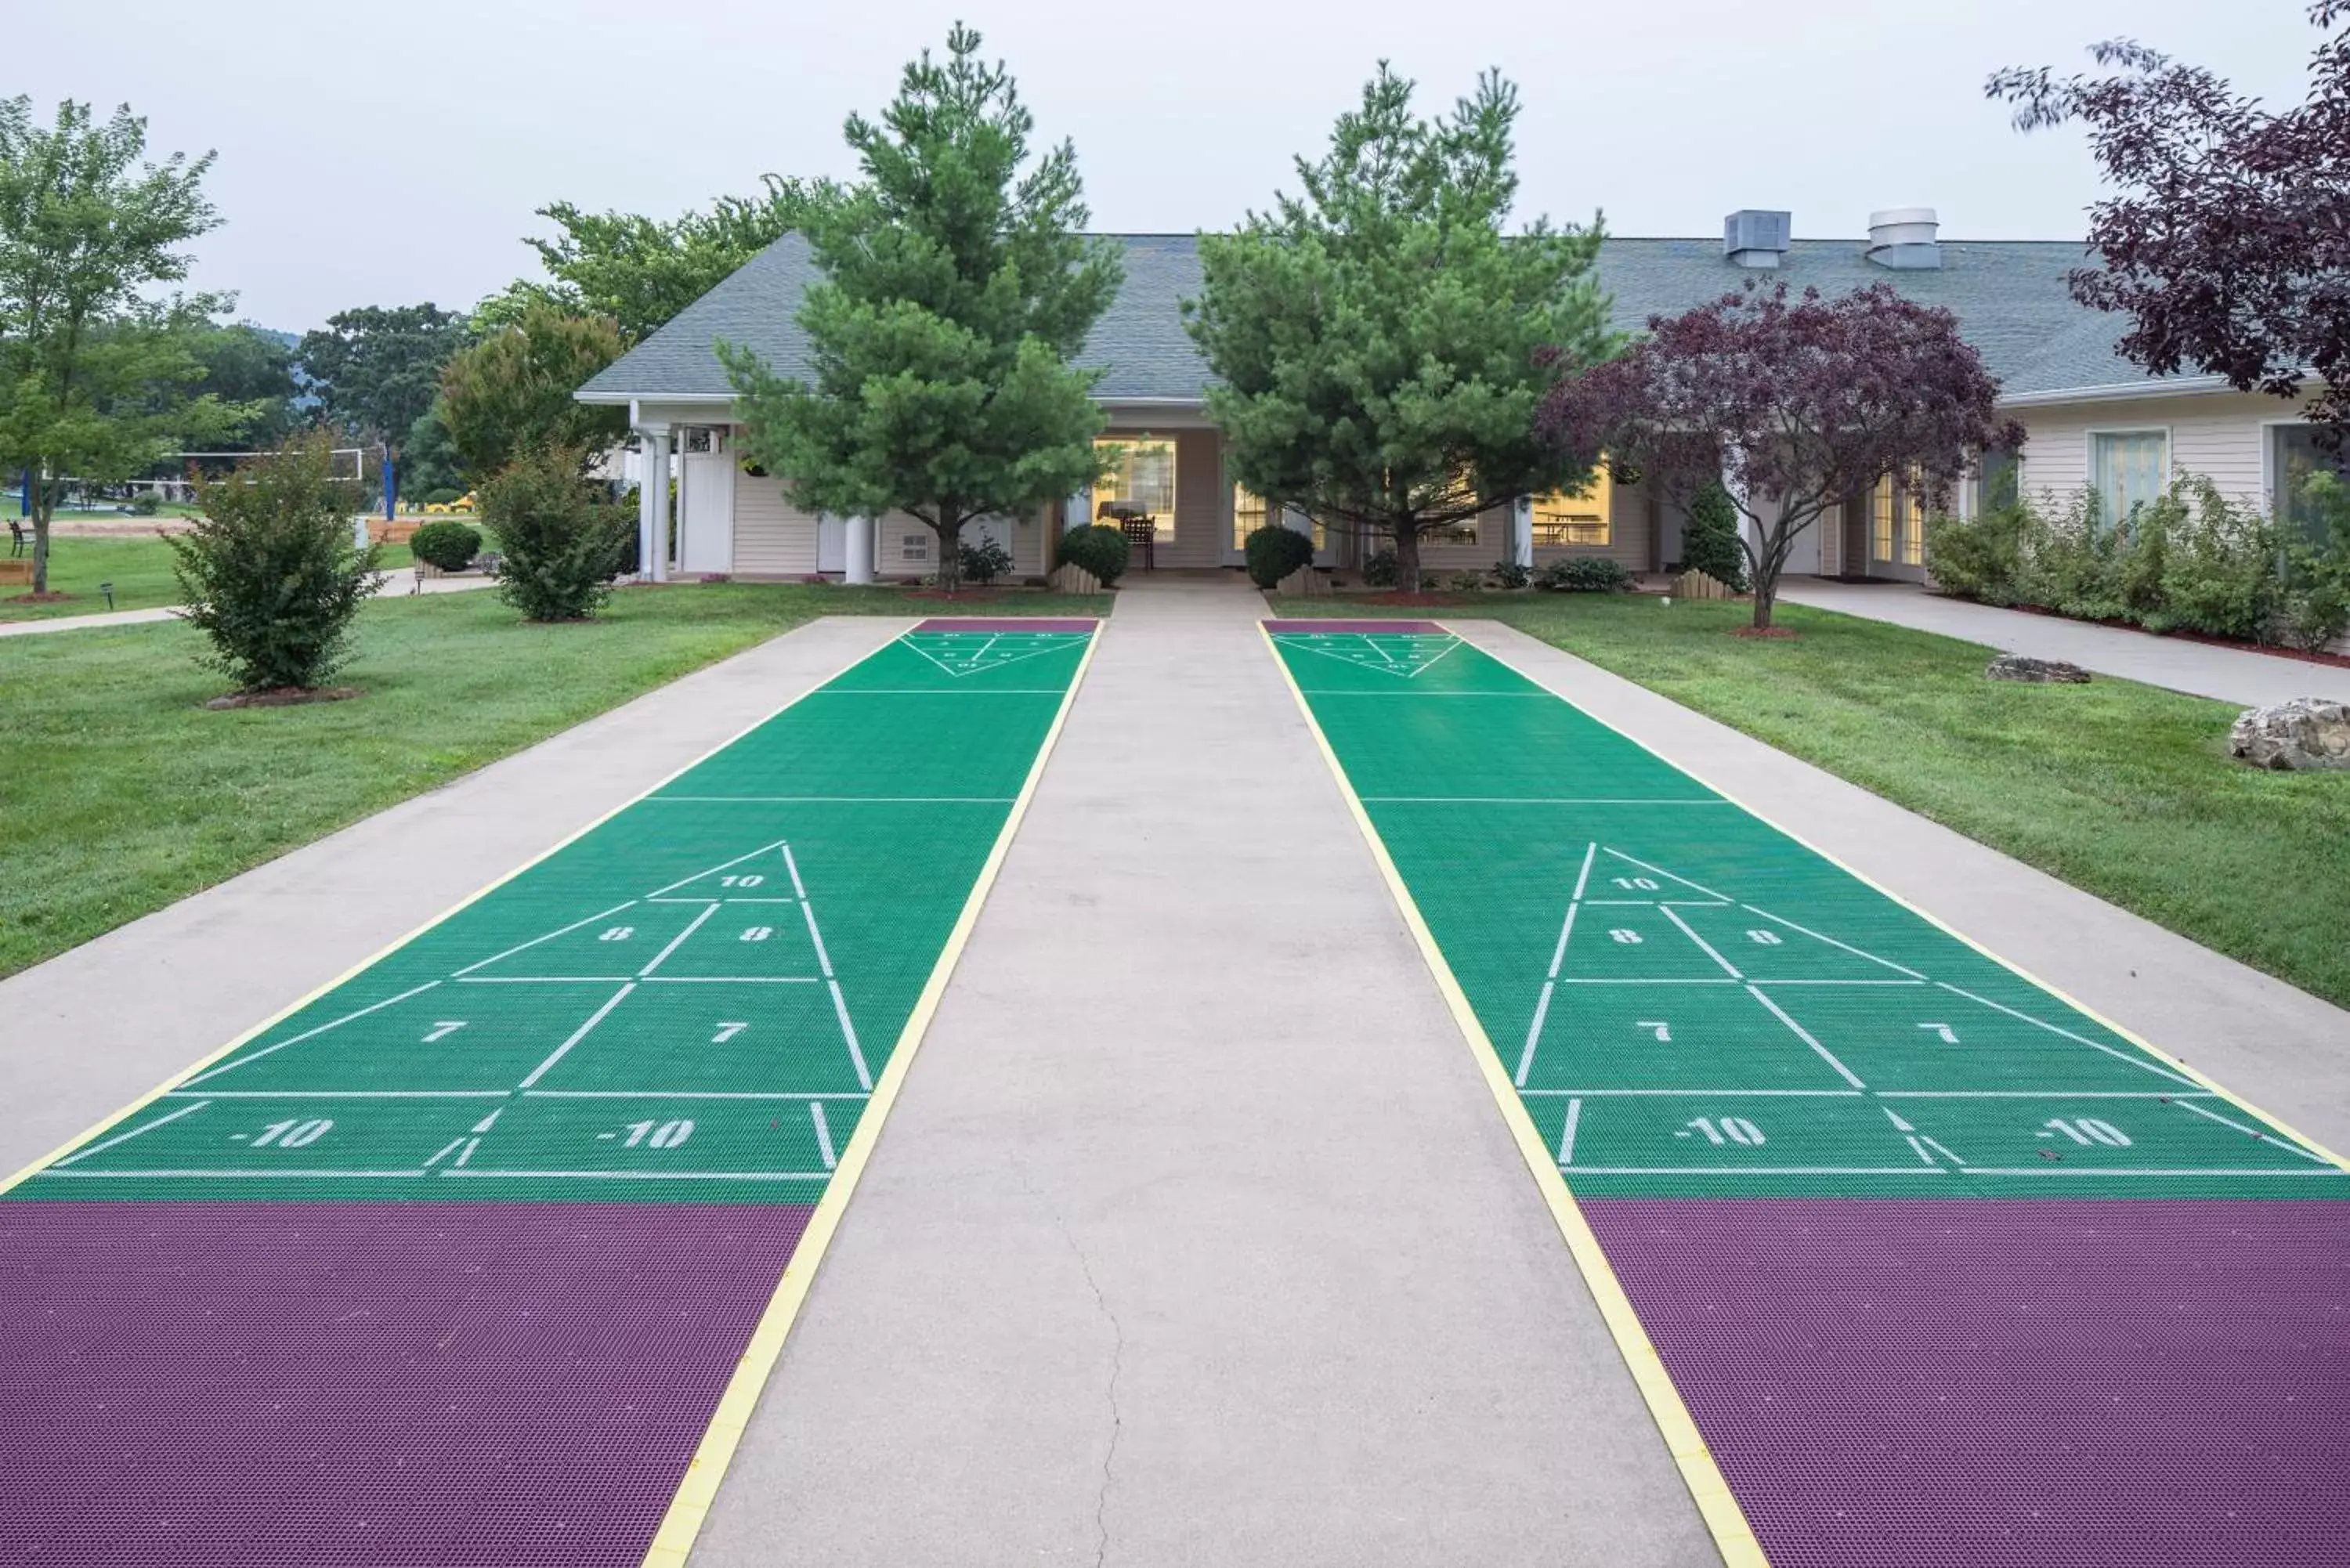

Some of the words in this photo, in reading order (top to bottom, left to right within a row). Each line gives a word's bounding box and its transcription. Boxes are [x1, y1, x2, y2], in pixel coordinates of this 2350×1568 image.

[720, 875, 765, 887] 10
[1611, 877, 1660, 891] 10
[421, 1020, 468, 1043] 7
[710, 1021, 749, 1043] 7
[1636, 1021, 1672, 1042] 7
[1917, 1022, 1960, 1044] 7
[230, 1118, 334, 1148] -10
[596, 1118, 696, 1149] -10
[1673, 1116, 1766, 1146] -10
[2034, 1118, 2133, 1147] -10
